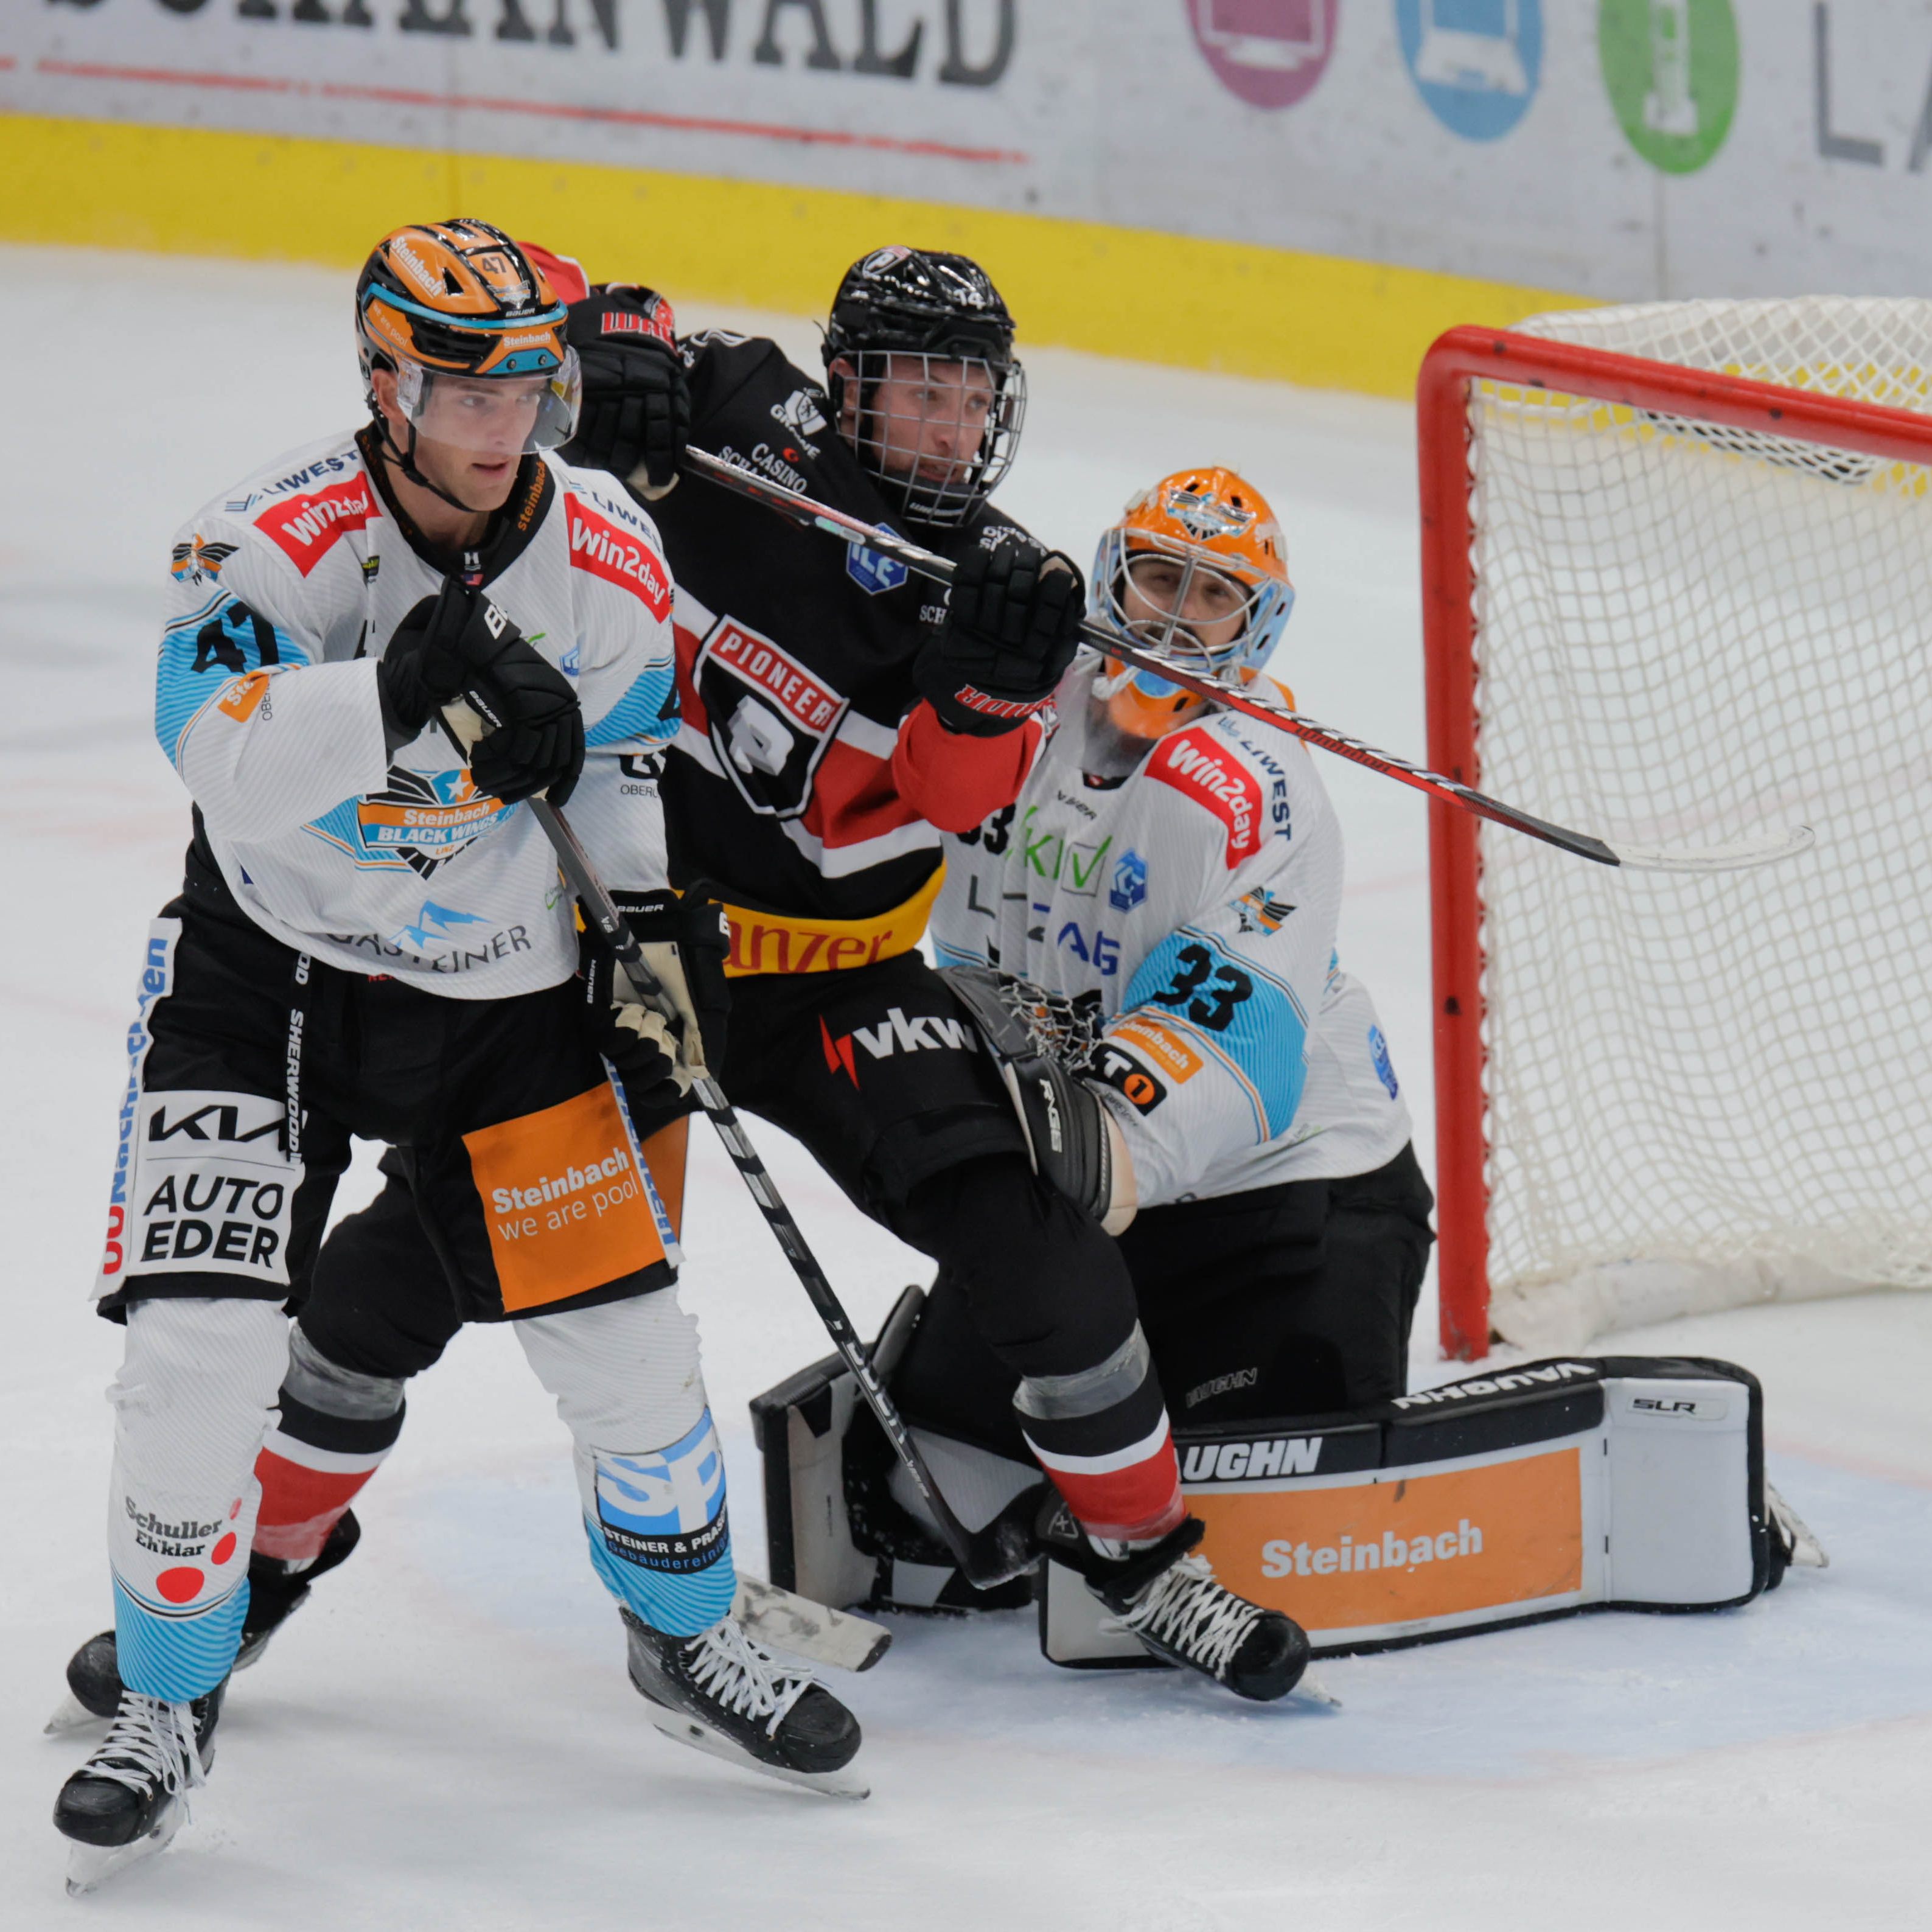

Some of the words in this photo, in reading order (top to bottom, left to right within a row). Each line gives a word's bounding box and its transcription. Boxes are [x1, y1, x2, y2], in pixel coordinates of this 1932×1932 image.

[391, 235, 442, 298] Steinbach
[482, 256, 507, 274] 47
[390, 327, 410, 346] pool
[506, 307, 535, 317] BAUER
[503, 332, 551, 347] Steinbach
[262, 449, 358, 495] LIWEST
[752, 443, 807, 493] CASINO
[572, 517, 666, 605] Win2day
[190, 601, 280, 674] 47
[719, 631, 835, 727] PIONEER
[469, 689, 503, 728] BAUER
[403, 803, 490, 826] Steinbach
[1167, 739, 1254, 849] Win2day
[1240, 739, 1291, 842] LIWEST
[377, 826, 448, 843] BLACK
[451, 812, 498, 840] WINGS
[436, 844, 455, 855] LINZ
[1153, 943, 1254, 1032] 33
[853, 1006, 978, 1060] vkw
[286, 1008, 304, 1152] SHERWOOD
[143, 1174, 285, 1221] AUTO
[492, 1146, 630, 1214] Steinbach
[498, 1217, 539, 1241] we
[547, 1199, 587, 1232] are
[591, 1171, 639, 1218] pool
[140, 1219, 279, 1269] EDER
[1391, 1362, 1597, 1411] VAUGHN
[1633, 1398, 1697, 1415] SLR
[125, 1496, 223, 1540] Schuller
[604, 1526, 669, 1554] STEINER
[674, 1541, 688, 1554] &
[1261, 1518, 1484, 1578] Steinbach
